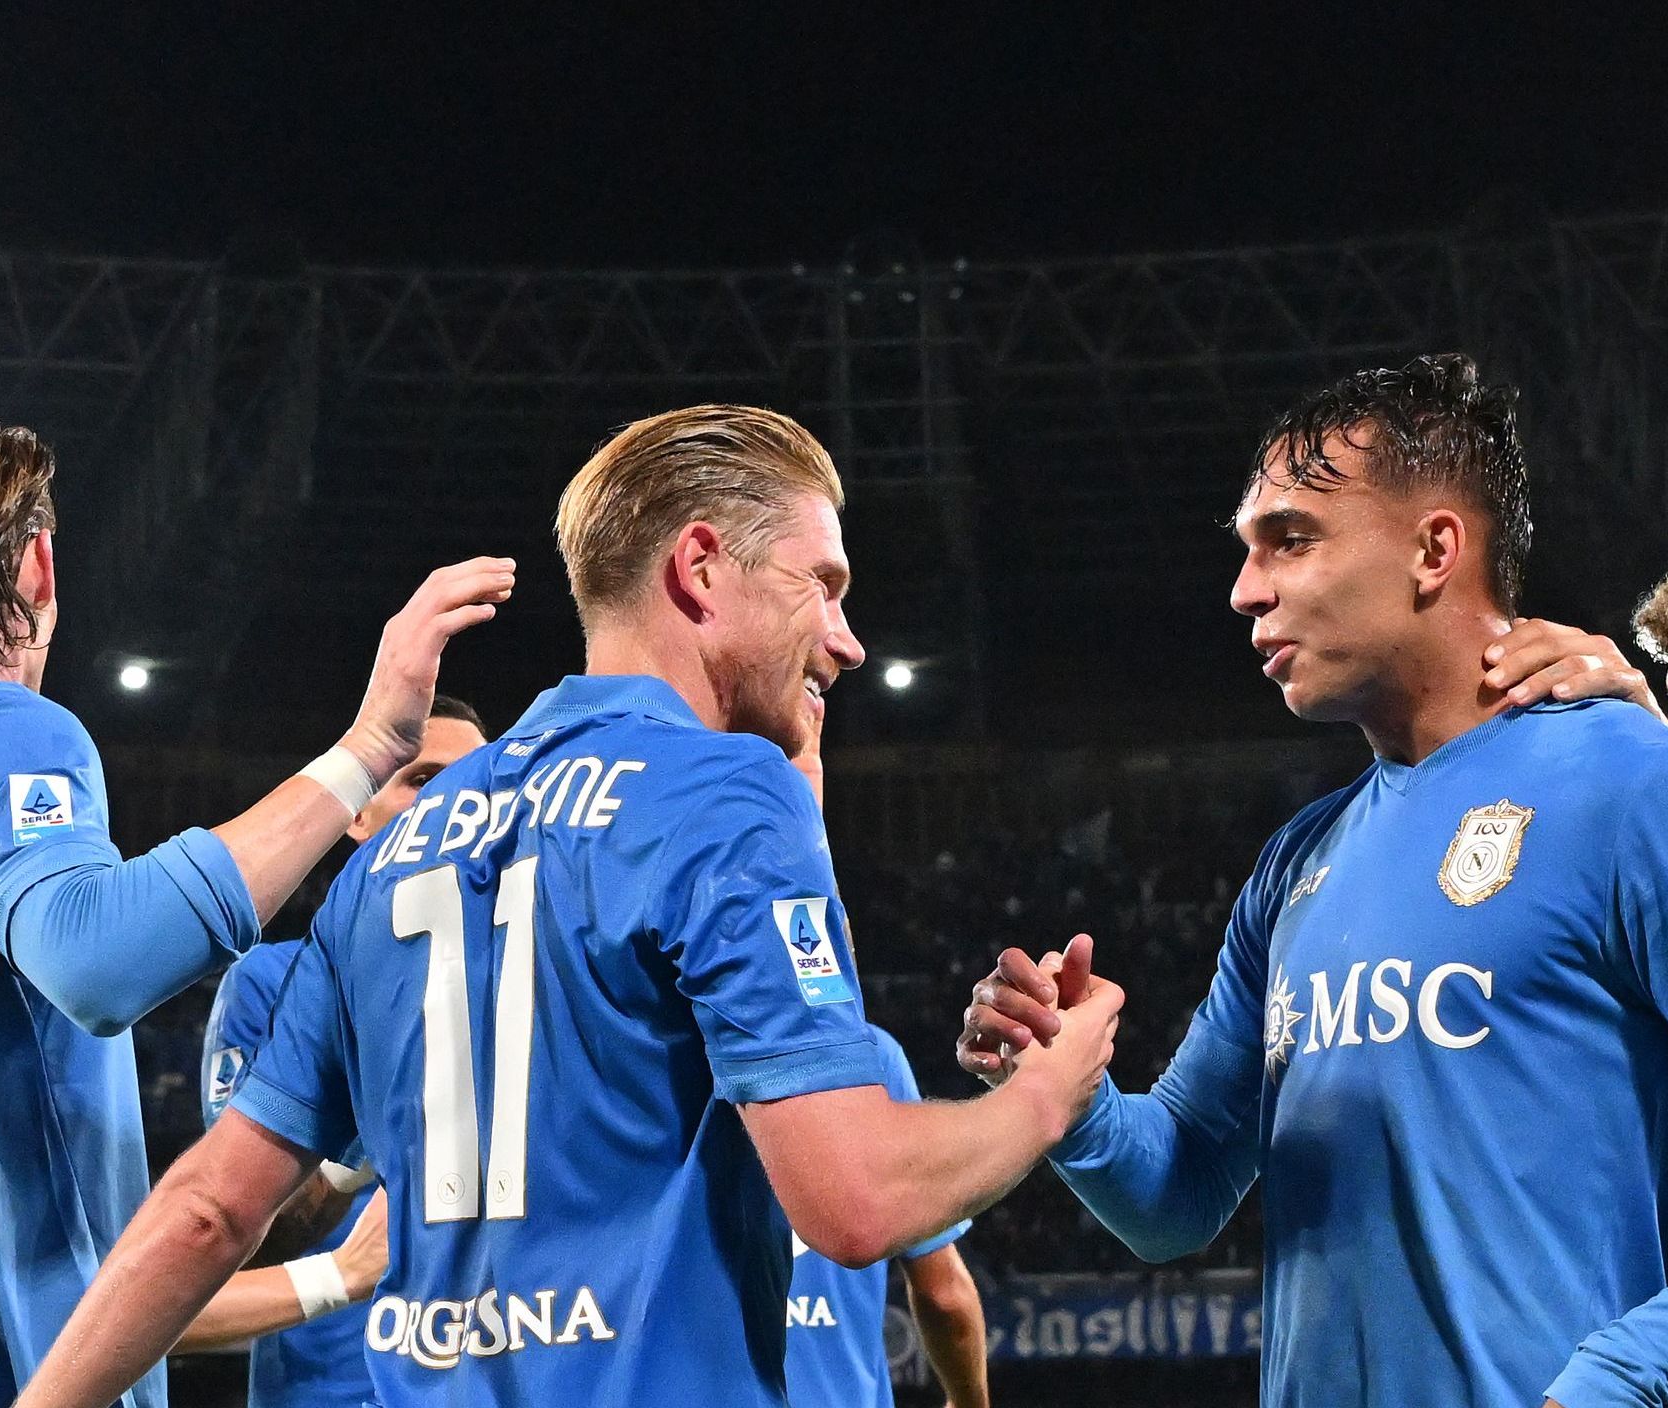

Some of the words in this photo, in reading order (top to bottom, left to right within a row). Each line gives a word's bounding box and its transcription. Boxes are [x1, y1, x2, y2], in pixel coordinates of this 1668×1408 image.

[21, 814, 52, 824] SERIE
[369, 794, 445, 873] DE
[438, 756, 646, 858] BRYNE
[1467, 852, 1488, 871] N
[797, 957, 821, 968] SERIE
[1302, 957, 1493, 1055] MSC
[392, 855, 540, 1223] 11
